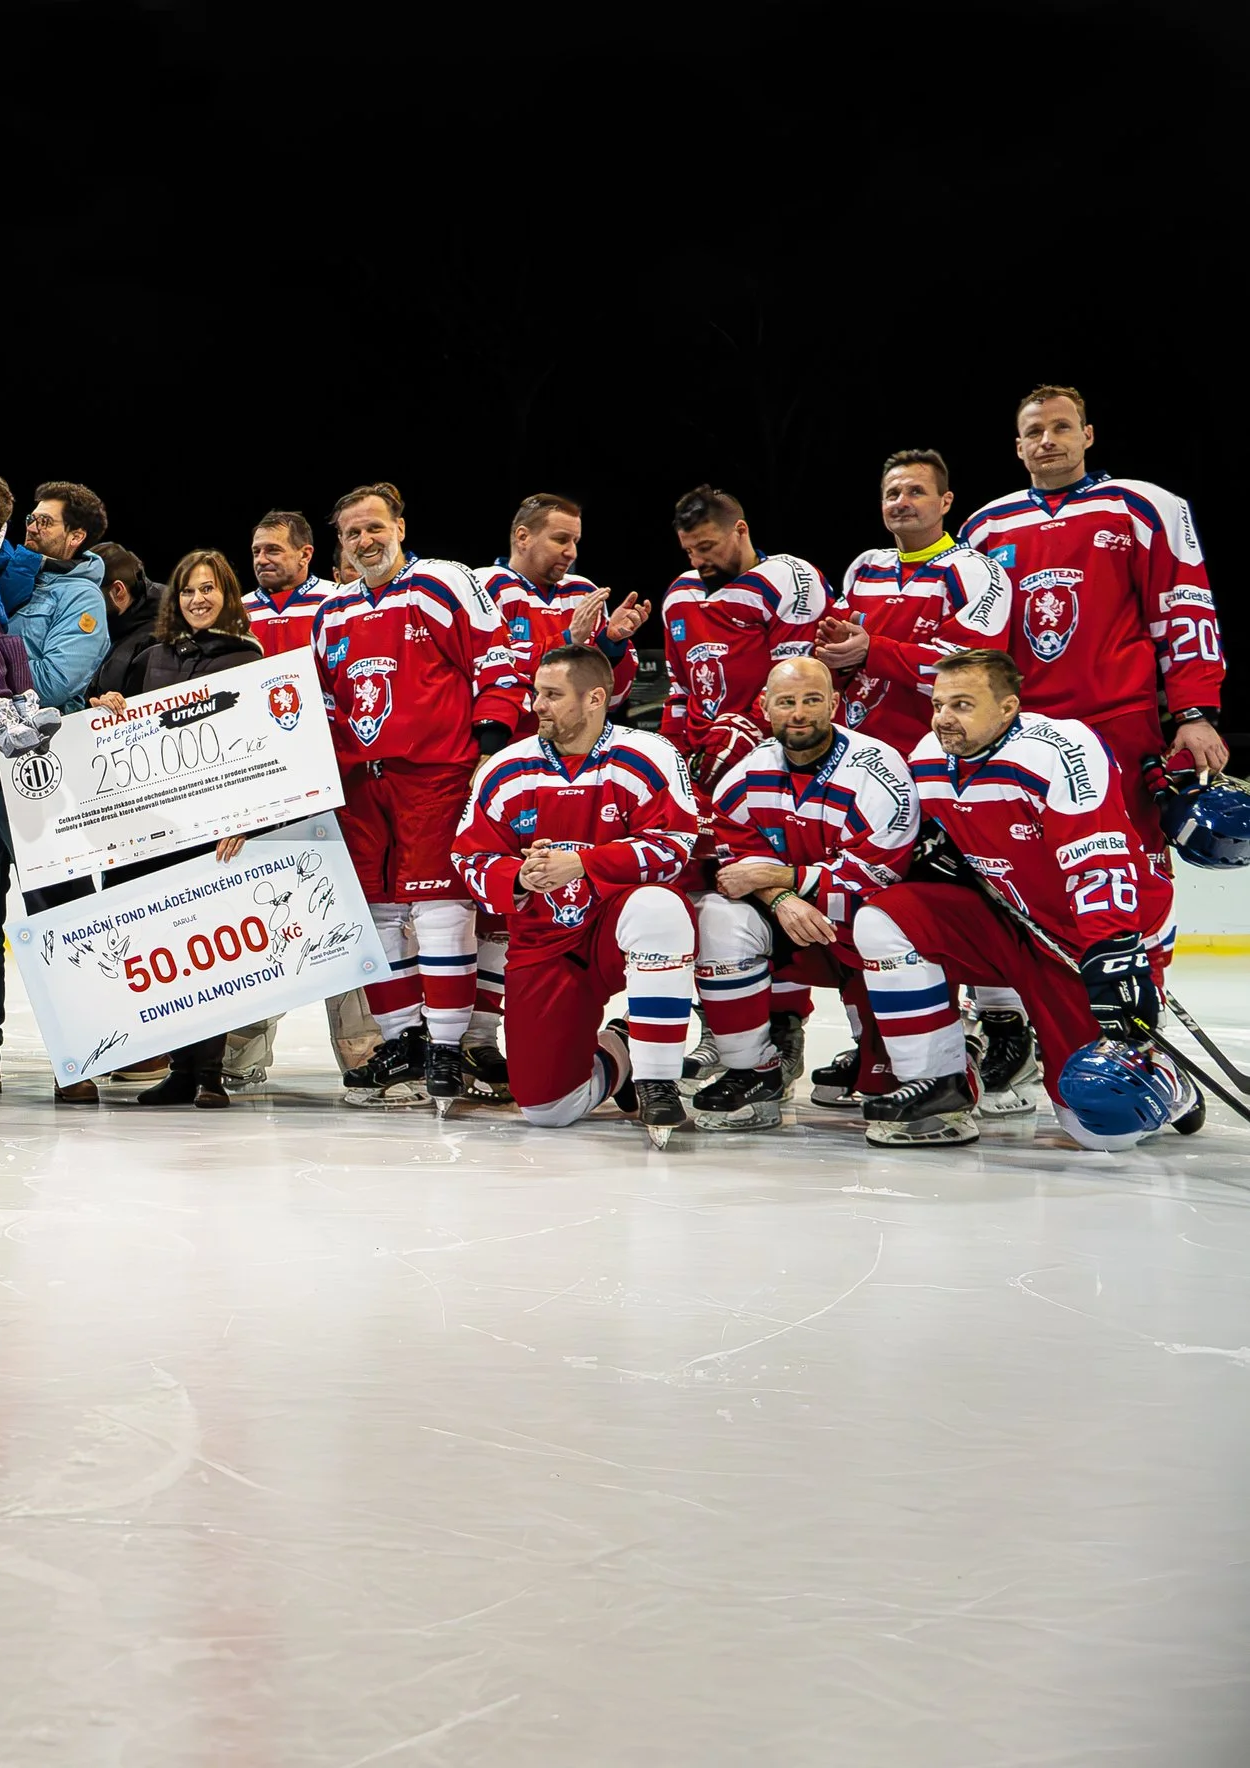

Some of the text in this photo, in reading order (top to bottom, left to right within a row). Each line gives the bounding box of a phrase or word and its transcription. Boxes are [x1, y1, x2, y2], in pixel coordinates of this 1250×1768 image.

[1171, 617, 1220, 661] 20
[260, 673, 301, 689] CZECHTEAM
[90, 684, 211, 731] CHARITATIVNÍ
[171, 698, 216, 722] UTKÁNÍ
[96, 736, 112, 748] Pro
[114, 722, 143, 740] Erička
[125, 727, 160, 747] Edvinka
[847, 747, 901, 785] Pilsner
[1063, 744, 1098, 801] Urquell
[20, 779, 58, 797] LEGENDS
[101, 805, 113, 813] byla
[136, 796, 144, 804] od
[61, 914, 114, 945] NADAČNÍ
[115, 908, 146, 927] FOND
[147, 876, 243, 916] MLÁDEŽNICKÉHO
[245, 855, 295, 882] FOTBALU
[405, 879, 452, 891] CCM
[1075, 868, 1138, 915] 26
[173, 914, 198, 928] DARUJE
[124, 915, 269, 993] 50.000
[281, 922, 303, 942] Kč
[139, 963, 285, 1023] EDWINU ALMQVISTOVI
